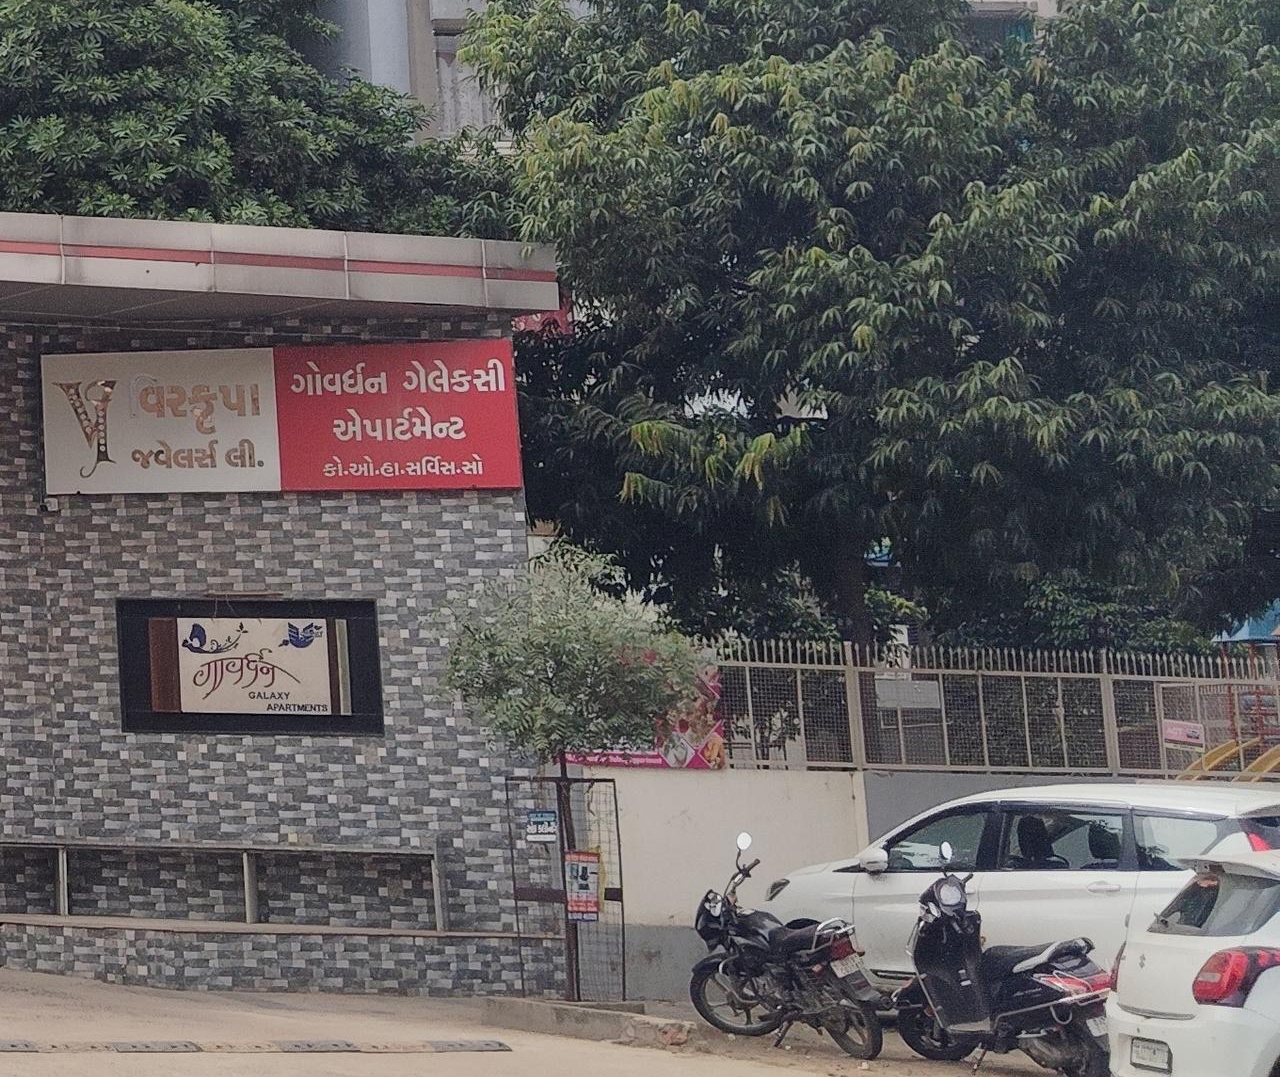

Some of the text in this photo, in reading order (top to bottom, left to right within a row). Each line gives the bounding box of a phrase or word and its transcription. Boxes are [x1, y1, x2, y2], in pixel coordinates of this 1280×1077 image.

[291, 361, 388, 396] ગોવર્ધન
[332, 406, 467, 442] એપાર્ટમેન્ટ
[248, 691, 290, 700] GALAXY
[266, 703, 328, 712] APARTMENTS
